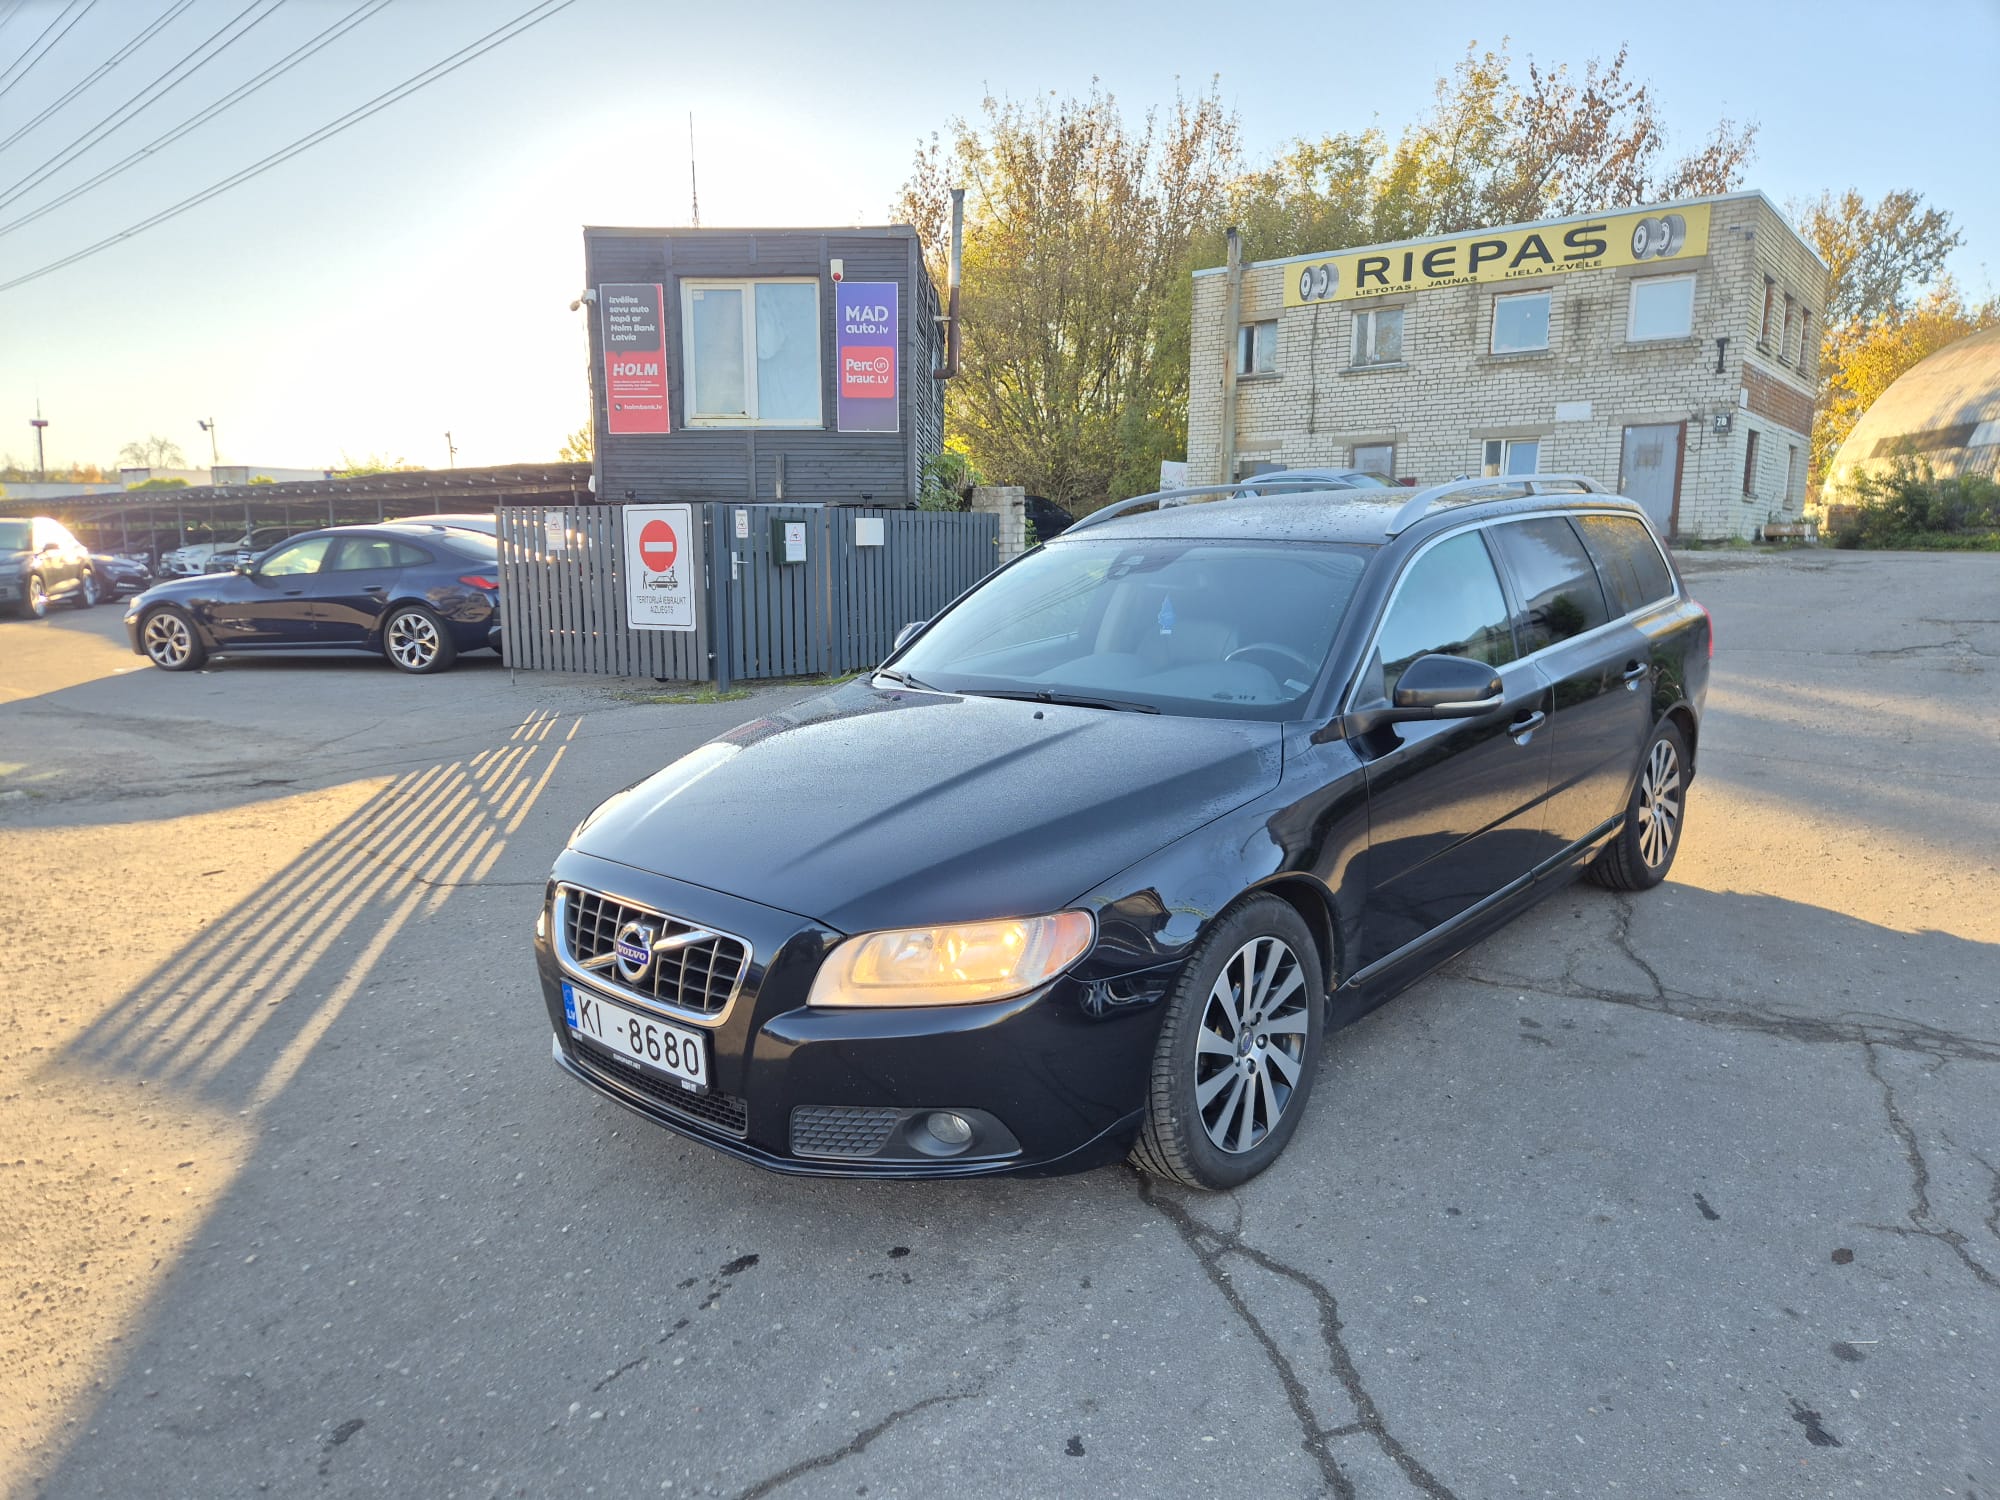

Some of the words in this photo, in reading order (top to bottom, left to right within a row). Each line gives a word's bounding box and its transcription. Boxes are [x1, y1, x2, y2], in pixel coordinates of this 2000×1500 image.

[1356, 224, 1607, 288] RIEPAS
[1428, 275, 1478, 288] JAUNAS
[1505, 267, 1543, 277] LIELA
[630, 305, 650, 313] auto
[845, 305, 889, 322] MAD
[610, 324, 632, 332] Holm
[633, 324, 655, 332] Bank
[845, 323, 889, 334] auto.lv
[611, 333, 637, 341] Latvia
[613, 363, 658, 376] HOLM
[845, 358, 873, 371] Perc
[618, 944, 647, 961] VOLVO
